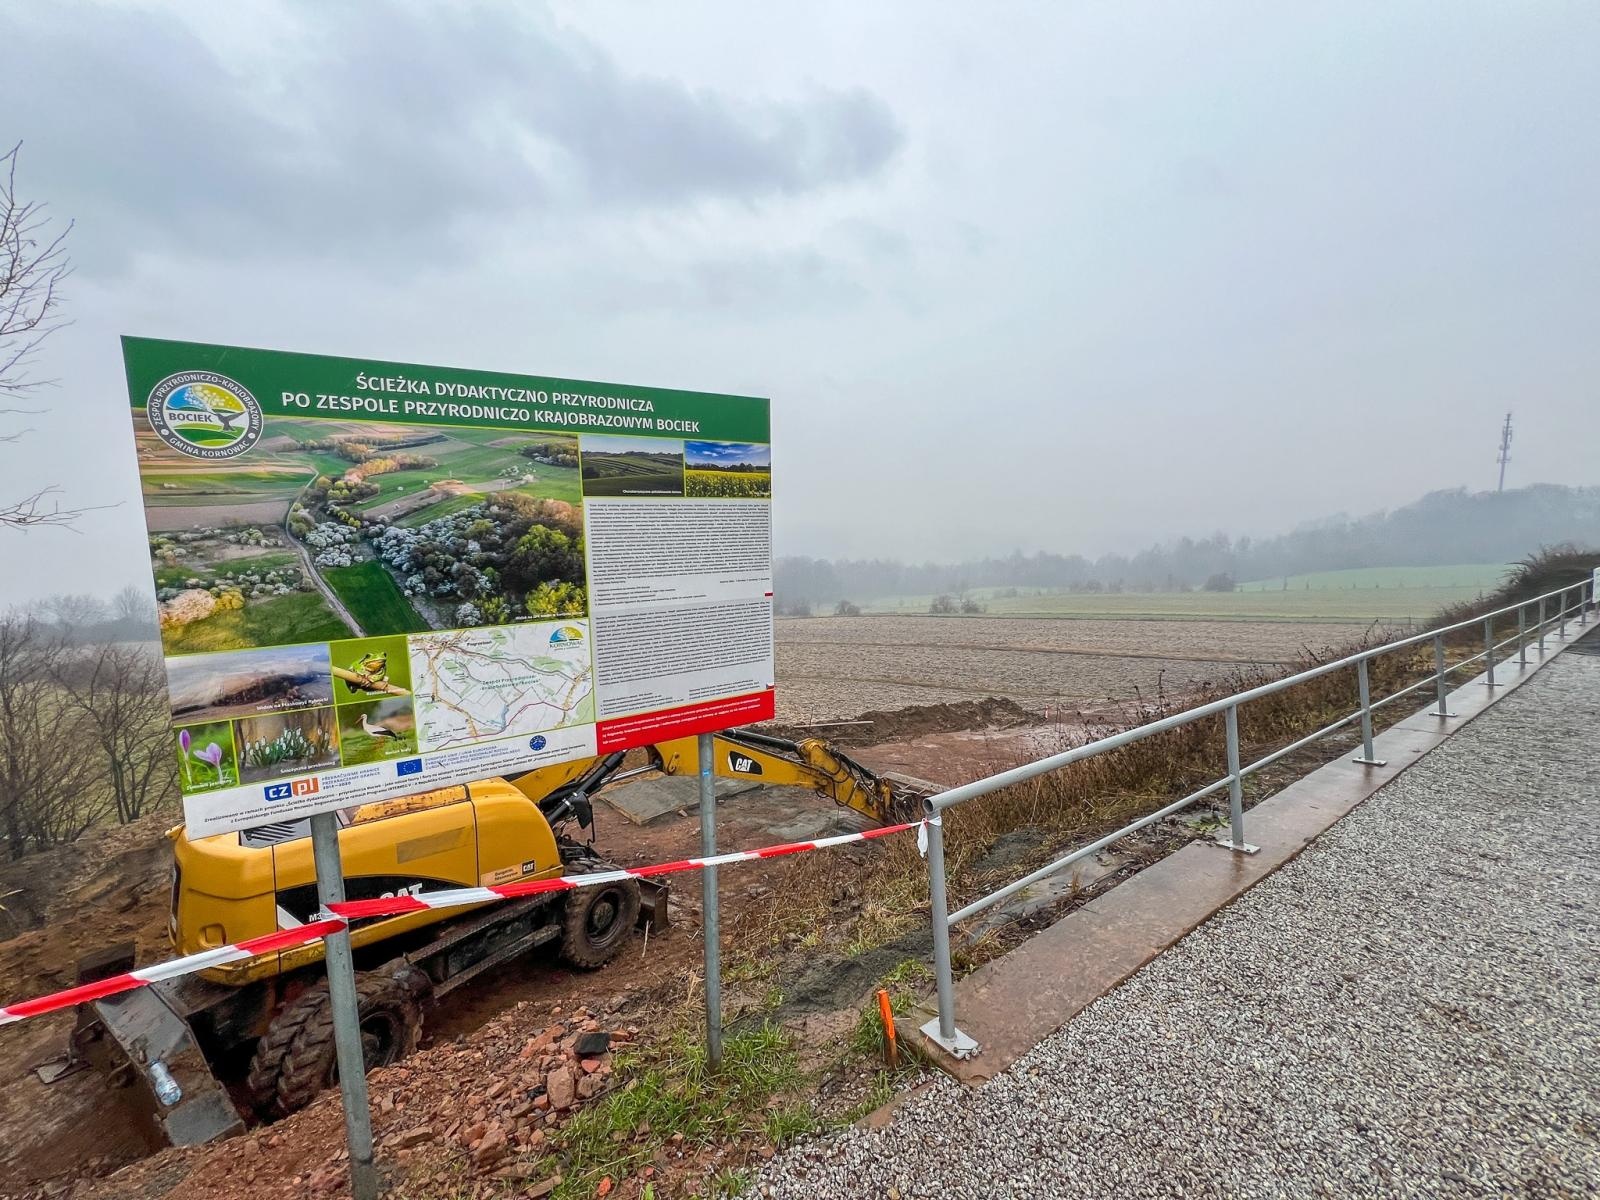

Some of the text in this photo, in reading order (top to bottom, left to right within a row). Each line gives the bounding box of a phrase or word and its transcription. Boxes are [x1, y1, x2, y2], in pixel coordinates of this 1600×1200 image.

[152, 374, 258, 430] ZESPÓŁ PRZYRODNICZO-KRAJOBRAZOWY
[356, 372, 654, 412] ŚCIEŻKA DYDAKTYCZNO PRZYRODNICZA
[169, 412, 213, 422] BOCIEK
[282, 392, 700, 432] PO ZESPOLE PRZYRODNICZO KRAJOBRAZOWYM BOCIEK
[170, 437, 250, 457] GMINA KORNOWAC
[735, 757, 752, 772] CAT
[268, 778, 314, 798] cz pl
[523, 863, 534, 872] CAT
